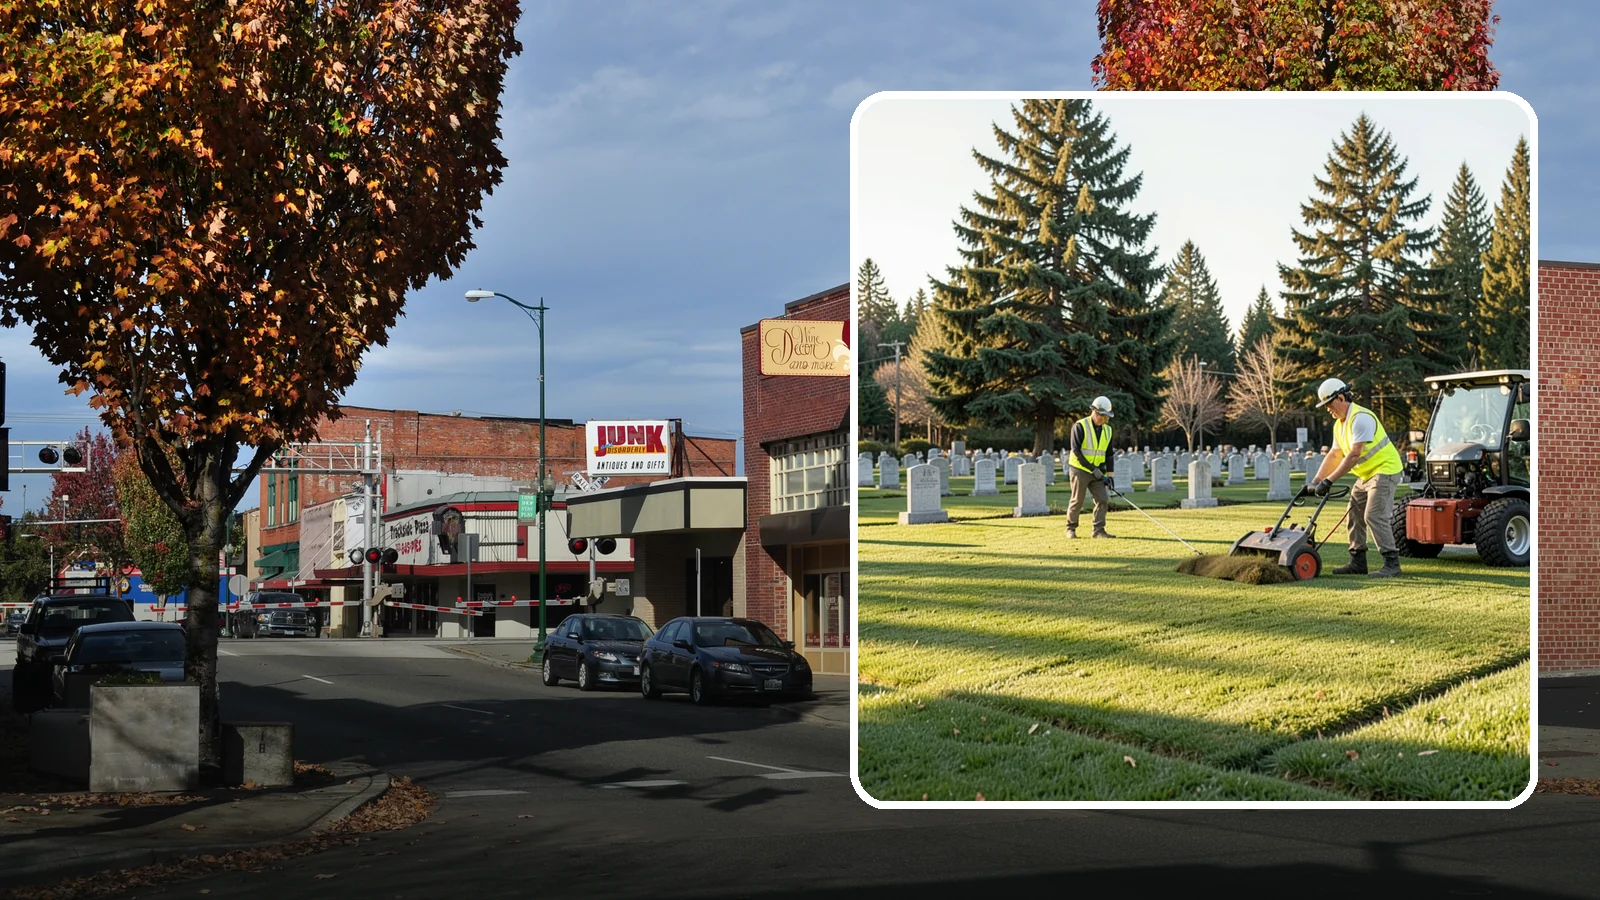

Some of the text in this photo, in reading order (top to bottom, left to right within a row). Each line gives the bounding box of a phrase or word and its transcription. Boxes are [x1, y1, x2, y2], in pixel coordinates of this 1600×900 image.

[595, 425, 664, 457] JUNK
[607, 446, 646, 454] DISORDERLY
[596, 460, 666, 470] ANTIQUES AND GIFTS
[414, 519, 429, 535] Pizza
